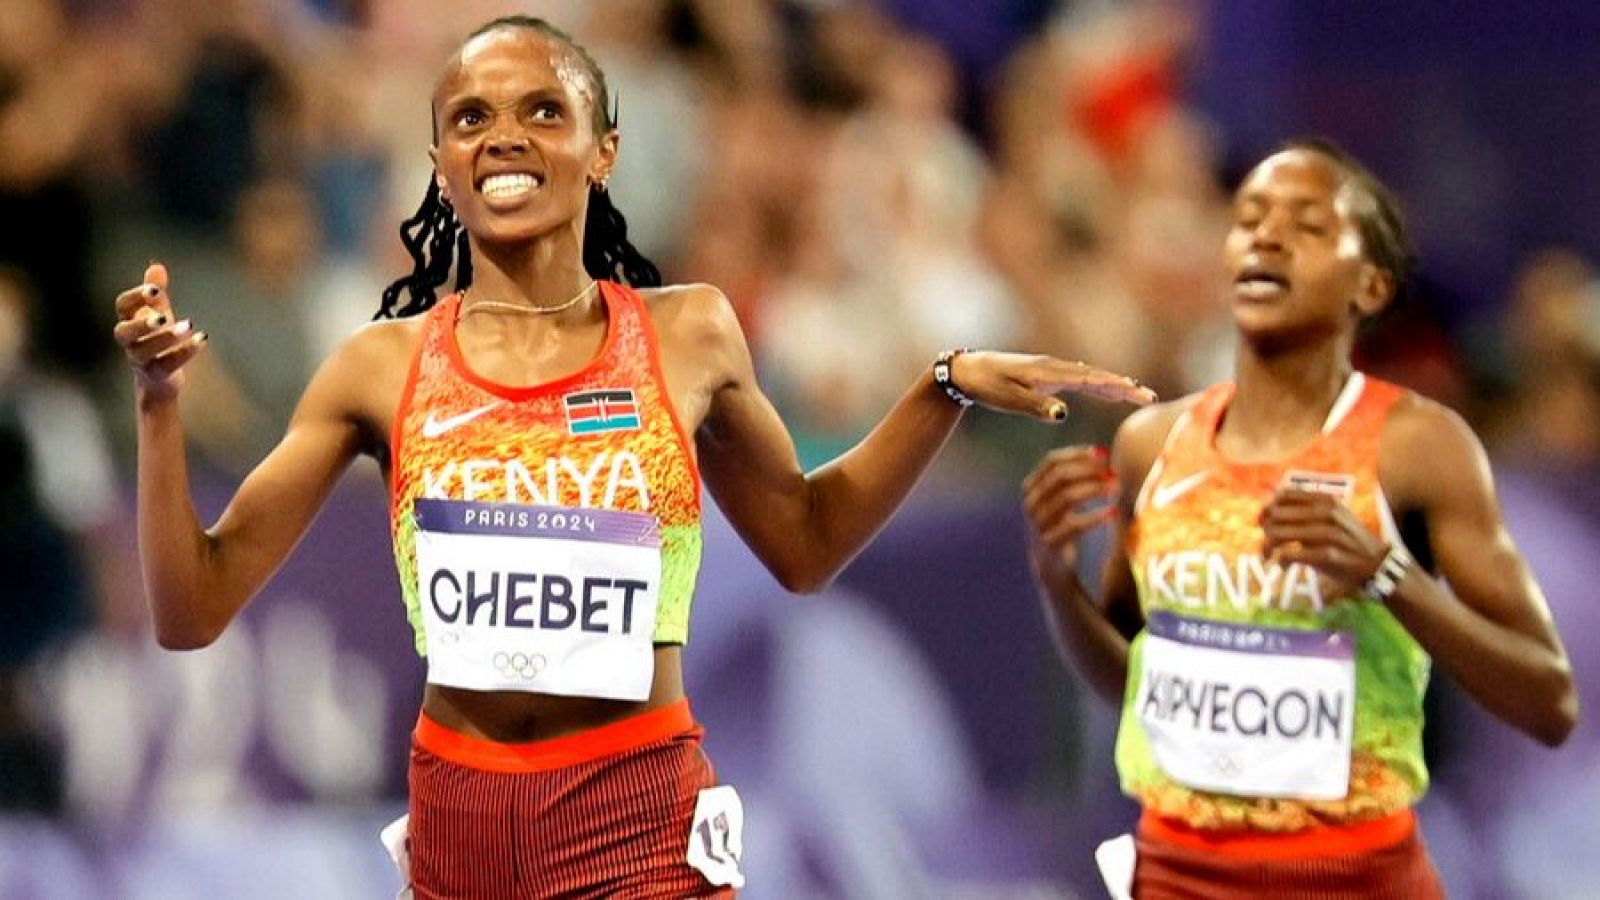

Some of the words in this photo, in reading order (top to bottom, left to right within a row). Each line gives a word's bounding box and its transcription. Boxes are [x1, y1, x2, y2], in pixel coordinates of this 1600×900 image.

[423, 451, 649, 509] KENYA
[465, 510, 528, 527] PARIS
[537, 513, 595, 531] 2024
[429, 568, 648, 634] CHEBET
[1148, 552, 1323, 612] KENYA
[1144, 670, 1343, 740] KIPYEGON
